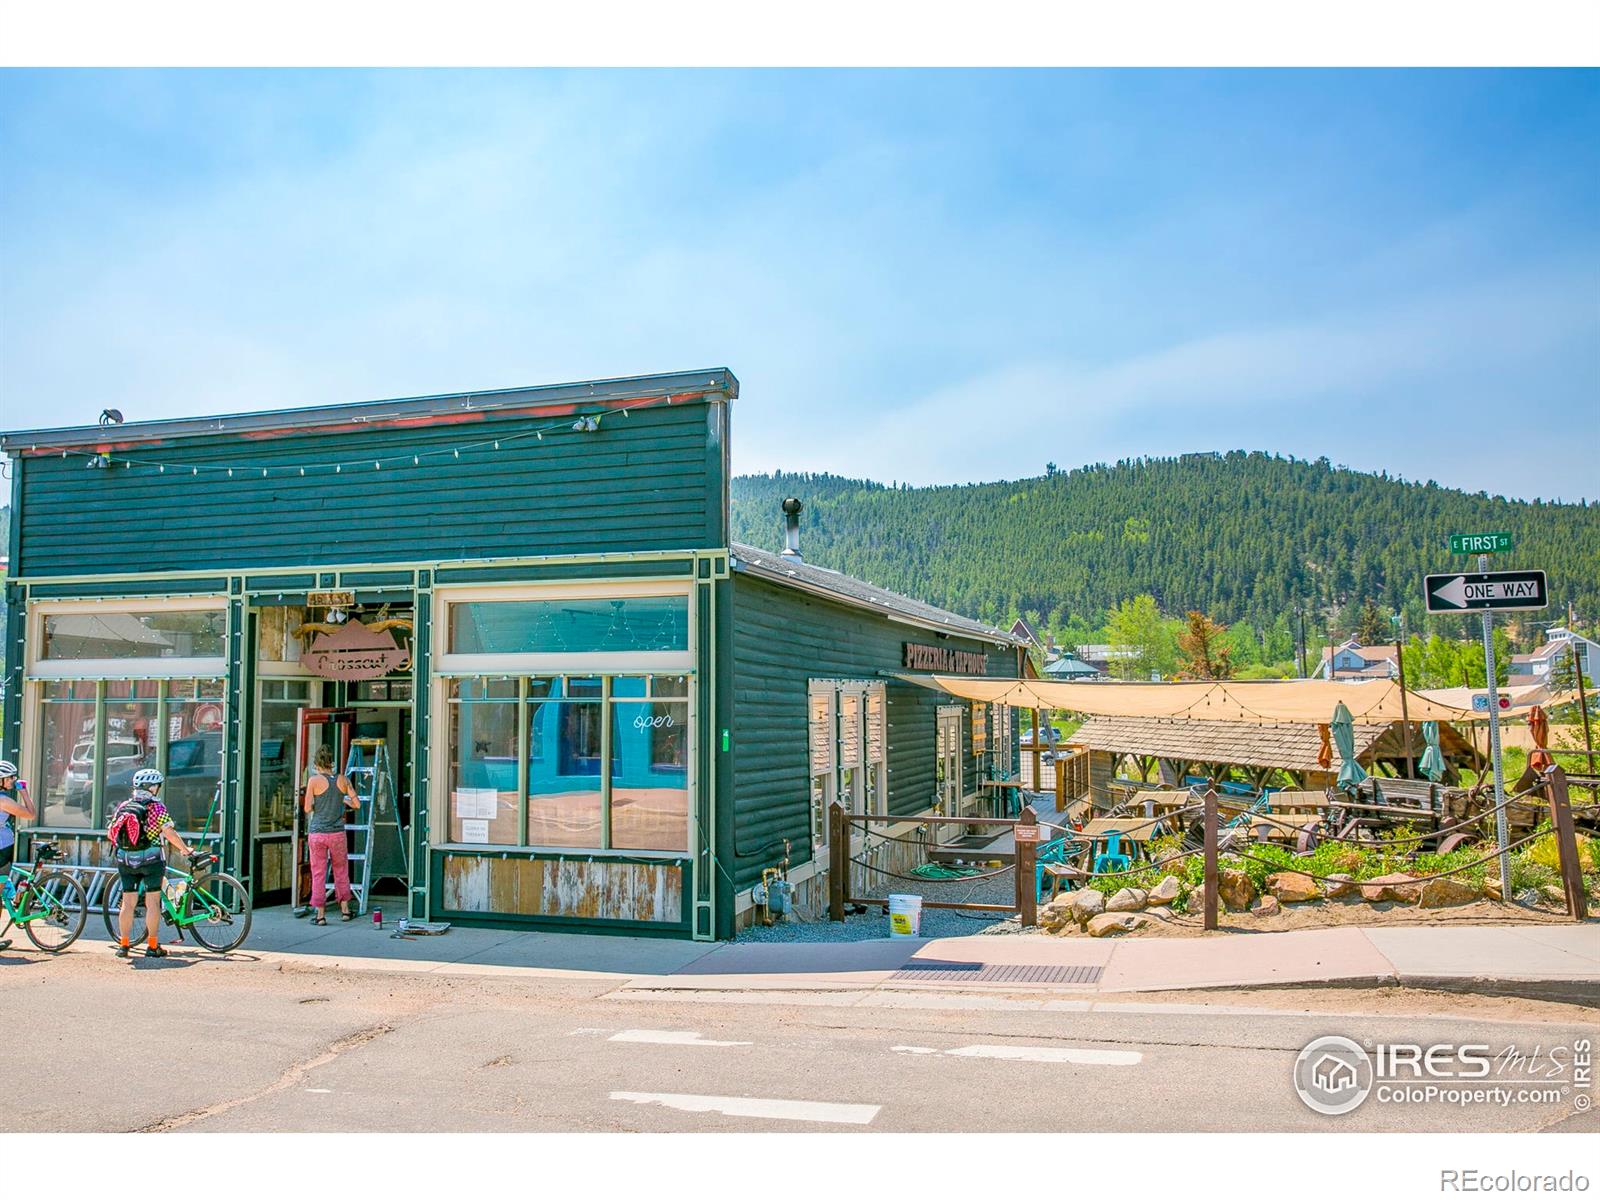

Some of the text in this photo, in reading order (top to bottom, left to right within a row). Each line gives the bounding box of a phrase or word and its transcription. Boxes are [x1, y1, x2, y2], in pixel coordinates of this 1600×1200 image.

[1453, 536, 1508, 551] E FIRST ST
[1464, 582, 1535, 598] ONE WAY
[906, 643, 948, 670] PIZZERIA
[949, 649, 955, 672] &
[633, 715, 674, 734] open
